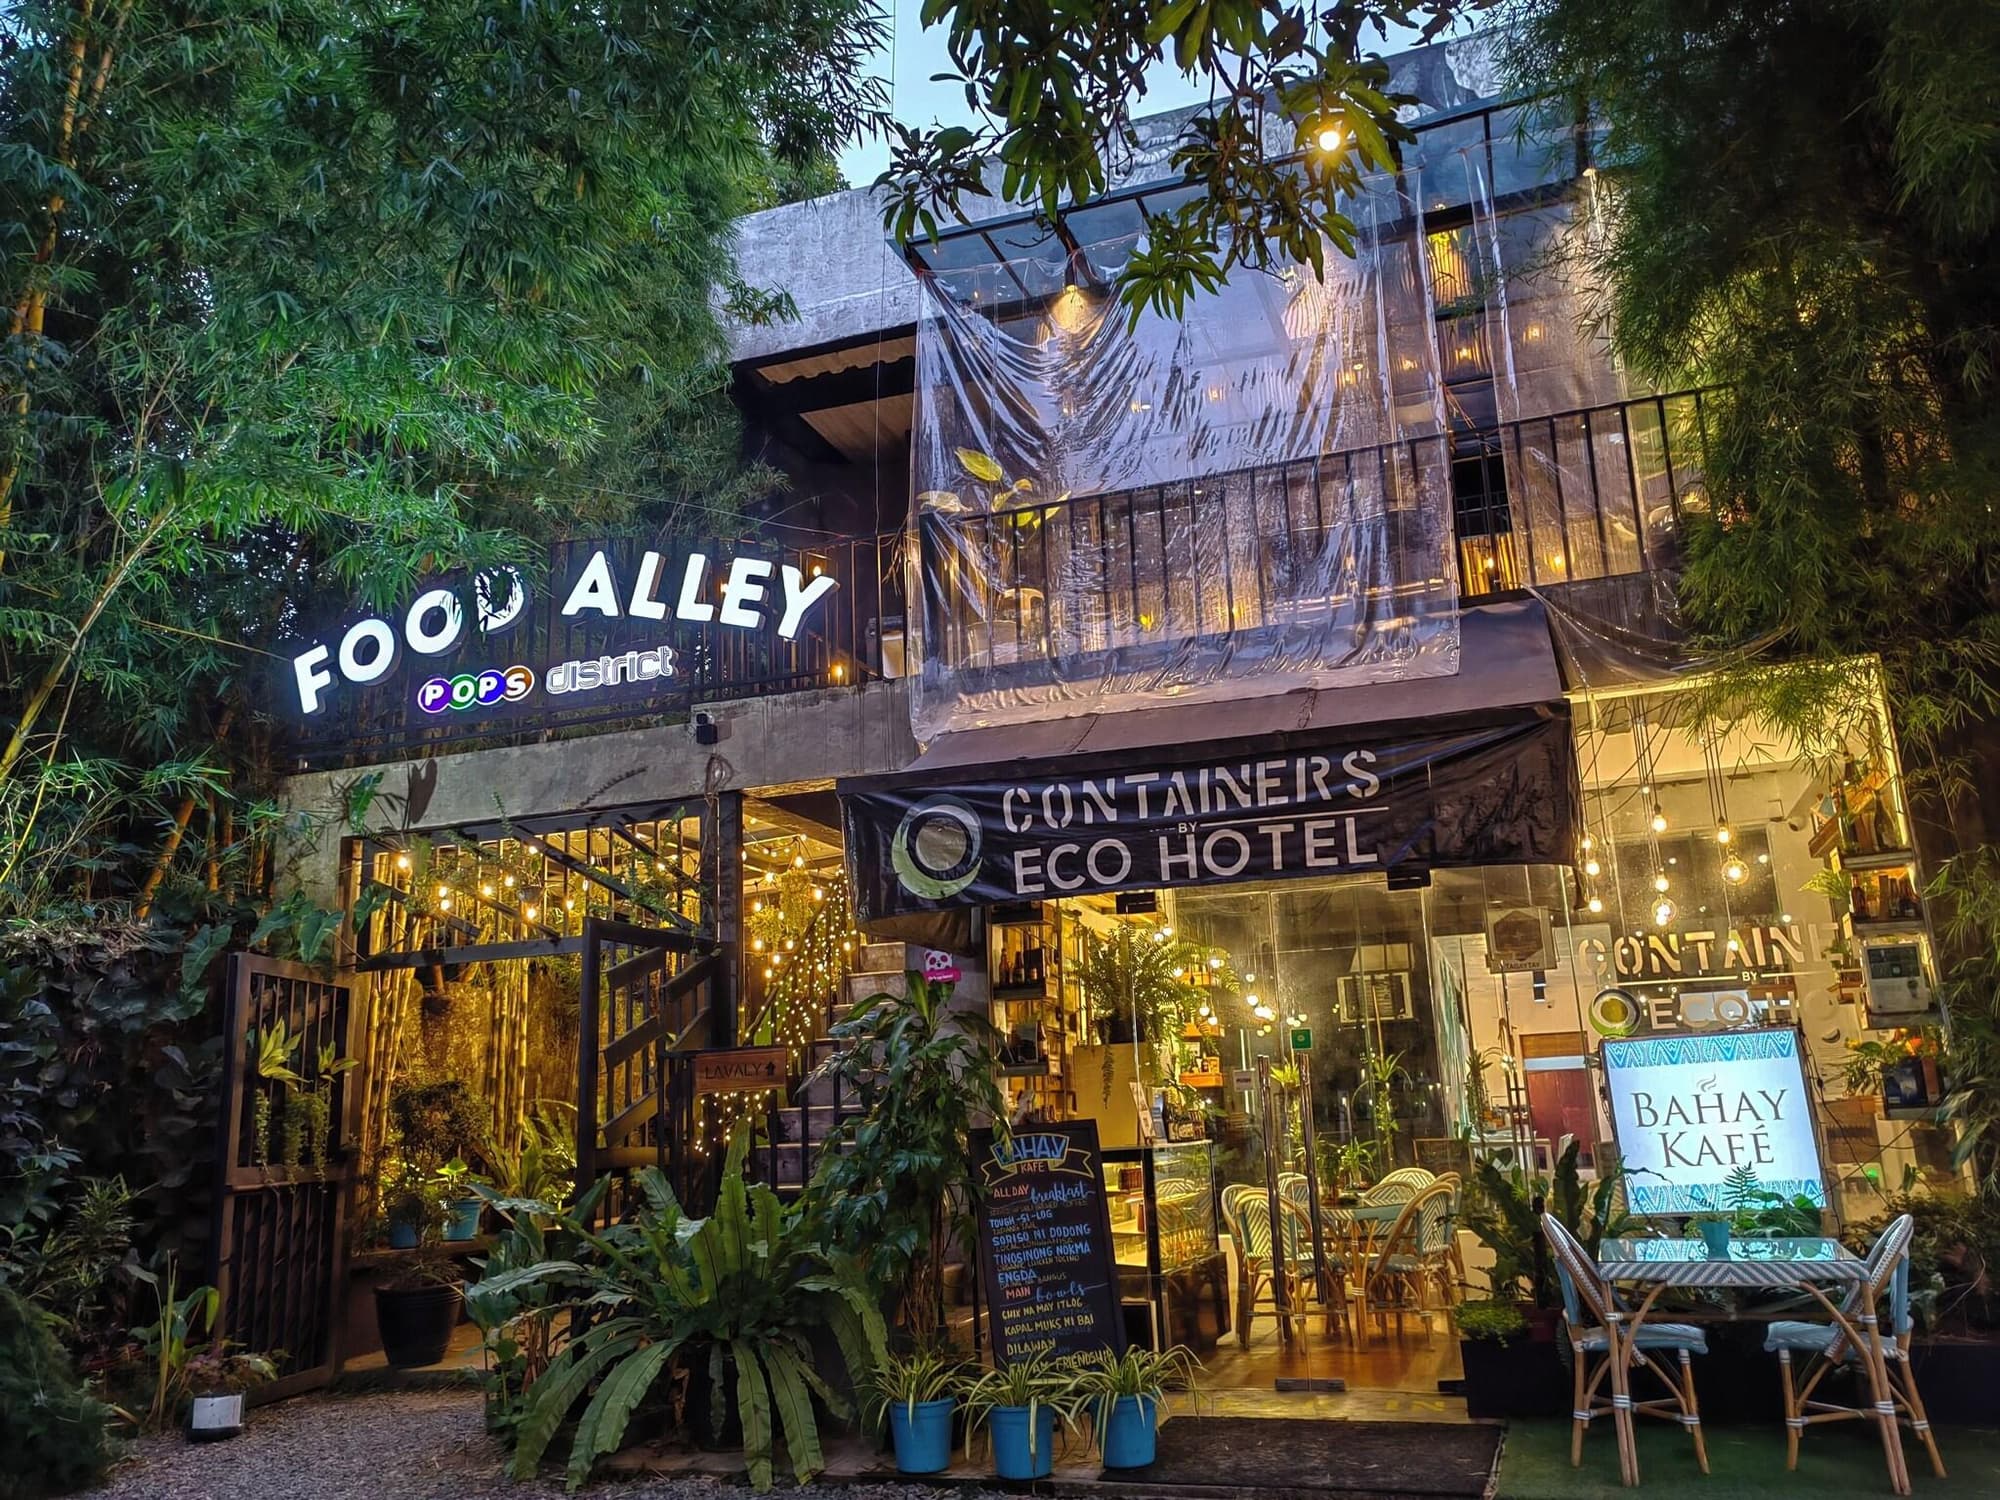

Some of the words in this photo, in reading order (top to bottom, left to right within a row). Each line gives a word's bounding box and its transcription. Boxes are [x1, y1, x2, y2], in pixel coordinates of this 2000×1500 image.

[293, 565, 525, 713] FOOD
[562, 550, 838, 640] ALLEY
[420, 666, 533, 711] POPS
[546, 646, 673, 694] district
[1003, 750, 1380, 833] CONTAINERS
[1178, 821, 1198, 833] BY
[1014, 838, 1132, 894] ECO
[1159, 816, 1378, 881] HOTEL
[1742, 971, 1759, 982] BY
[1651, 990, 1749, 1030] ECO
[705, 1063, 761, 1080] LAVALY
[1630, 1088, 1788, 1128] BAHAY
[1658, 1123, 1774, 1168] KAFÉ
[1020, 1161, 1046, 1173] KAFE
[993, 1186, 1011, 1199] ALL
[1012, 1183, 1029, 1196] DAY
[1030, 1180, 1090, 1204] breakfast
[992, 1231, 1029, 1246] SORISO
[1034, 1229, 1046, 1240] NI
[1049, 1223, 1091, 1239] DODONG
[1056, 1240, 1091, 1256] NOKMA
[998, 1268, 1037, 1284] ENGDA
[1005, 1286, 1031, 1300] MAIN
[1036, 1280, 1085, 1302] bowls
[1023, 1306, 1036, 1316] NA
[1036, 1302, 1054, 1313] MAY
[1057, 1297, 1083, 1310] ITLOG
[1004, 1322, 1033, 1336] KAPAL
[1035, 1317, 1061, 1330] MUKS
[1064, 1315, 1075, 1327] NI
[1077, 1313, 1094, 1325] BAI
